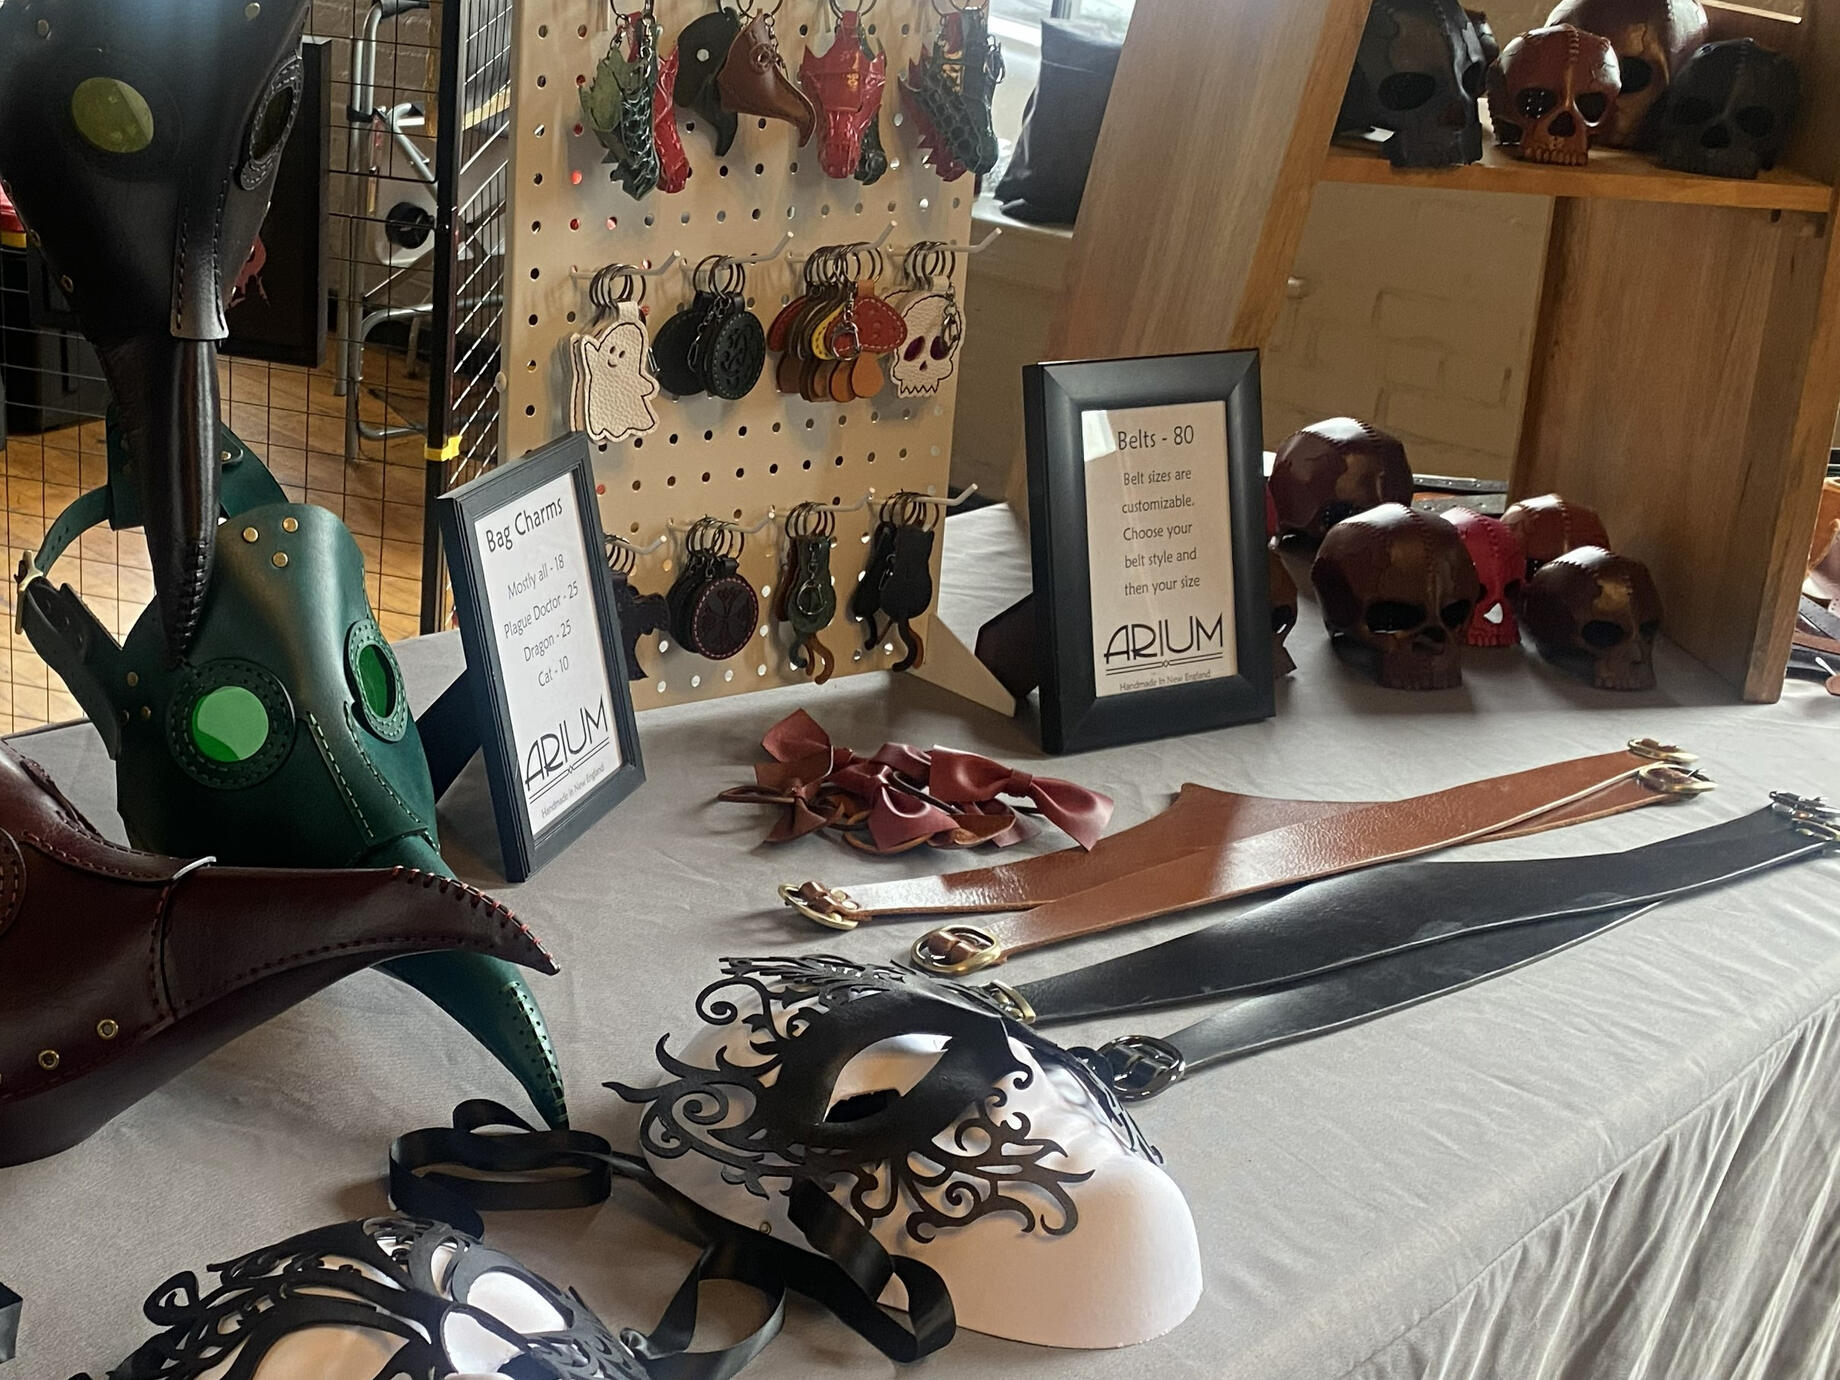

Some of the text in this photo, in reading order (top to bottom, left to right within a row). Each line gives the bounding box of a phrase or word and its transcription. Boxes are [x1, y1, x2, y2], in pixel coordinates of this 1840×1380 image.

[1118, 428, 1156, 450] Belts
[1173, 424, 1194, 446] 80
[1123, 469, 1192, 486] Belt sizes are
[1122, 494, 1195, 514] customizable.
[486, 498, 562, 552] Bag Charms
[1123, 524, 1192, 541] Choose your
[1124, 546, 1197, 568] belt style and
[508, 573, 536, 600] Mostly
[538, 562, 548, 582] all
[554, 554, 564, 571] 18
[1124, 576, 1200, 596] then your size
[504, 614, 532, 639] Plague
[532, 595, 560, 620] Doctor
[568, 580, 579, 599] 25
[524, 634, 554, 662] Dragon
[560, 618, 572, 638] 25
[1104, 611, 1223, 664] ARIUM
[538, 668, 553, 686] Cat
[560, 656, 569, 672] 10
[1120, 678, 1158, 691] Handmade
[1166, 674, 1184, 684] New
[1184, 669, 1211, 682] England
[525, 694, 608, 792] ARIUM
